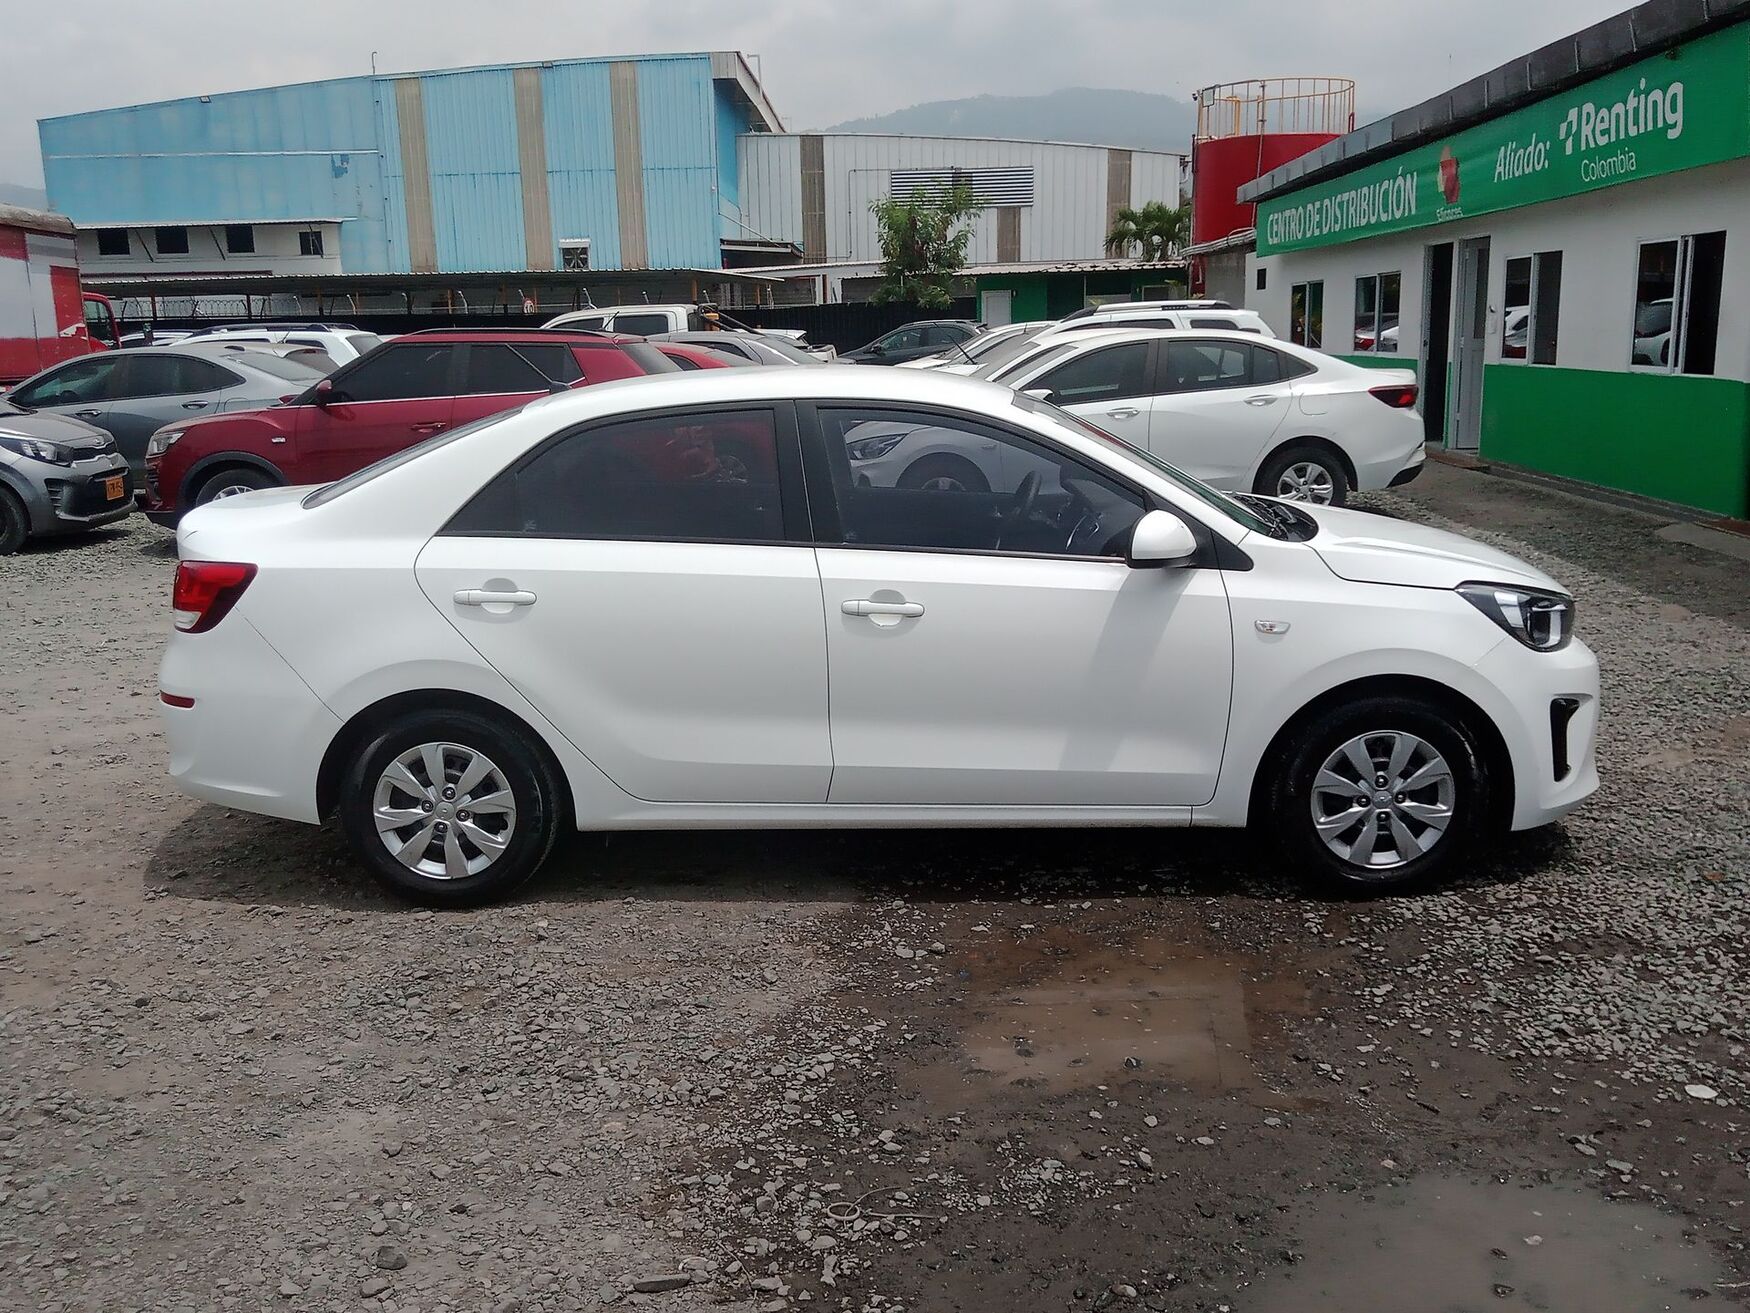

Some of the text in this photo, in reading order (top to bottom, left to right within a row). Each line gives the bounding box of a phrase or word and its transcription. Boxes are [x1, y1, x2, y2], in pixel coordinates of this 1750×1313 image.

[1580, 77, 1684, 151] Renting
[1493, 133, 1550, 183] Aliado:
[1581, 147, 1637, 182] Colombia
[1267, 166, 1418, 245] CENTRO DE DISTRIBUCIÓN
